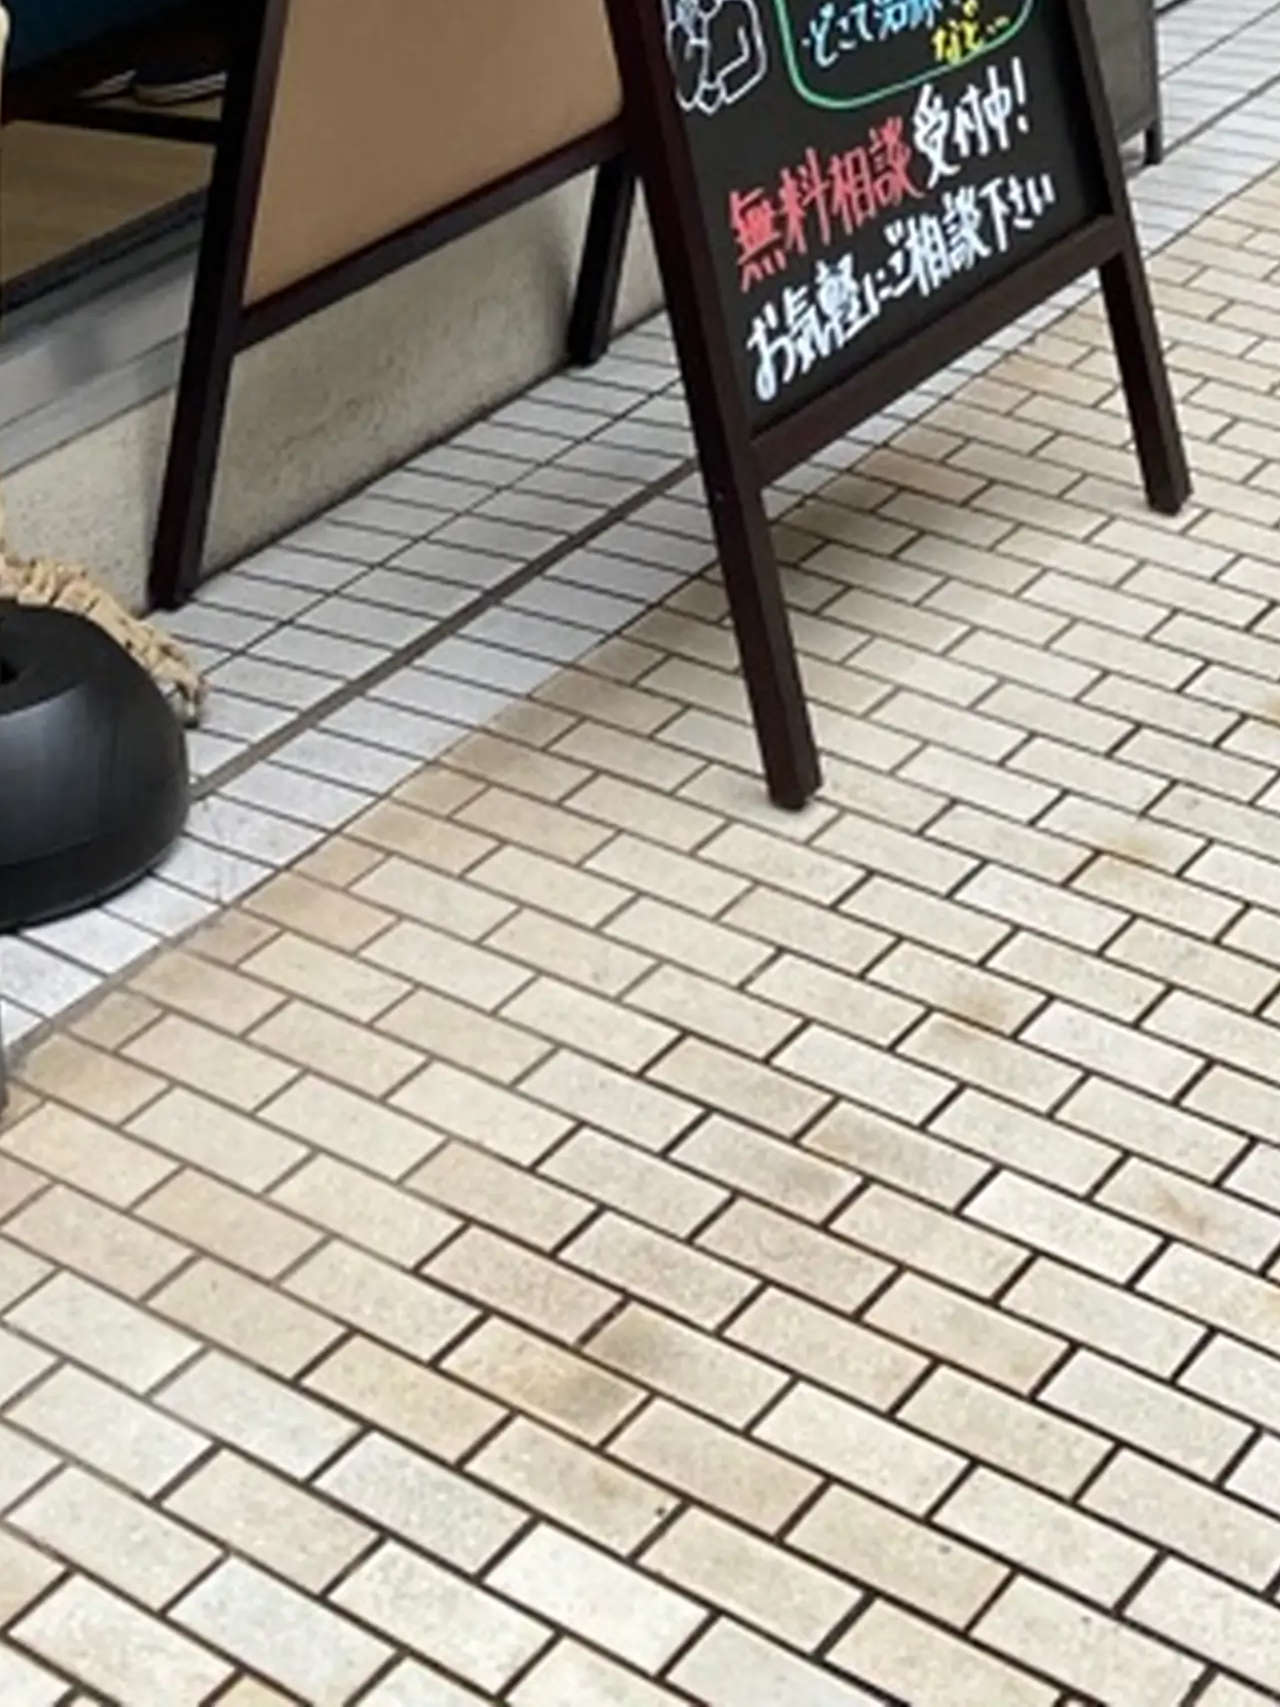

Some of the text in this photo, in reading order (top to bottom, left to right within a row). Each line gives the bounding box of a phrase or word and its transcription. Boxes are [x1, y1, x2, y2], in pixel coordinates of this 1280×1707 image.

[746, 172, 1058, 403] お気軽にご相談下さい
